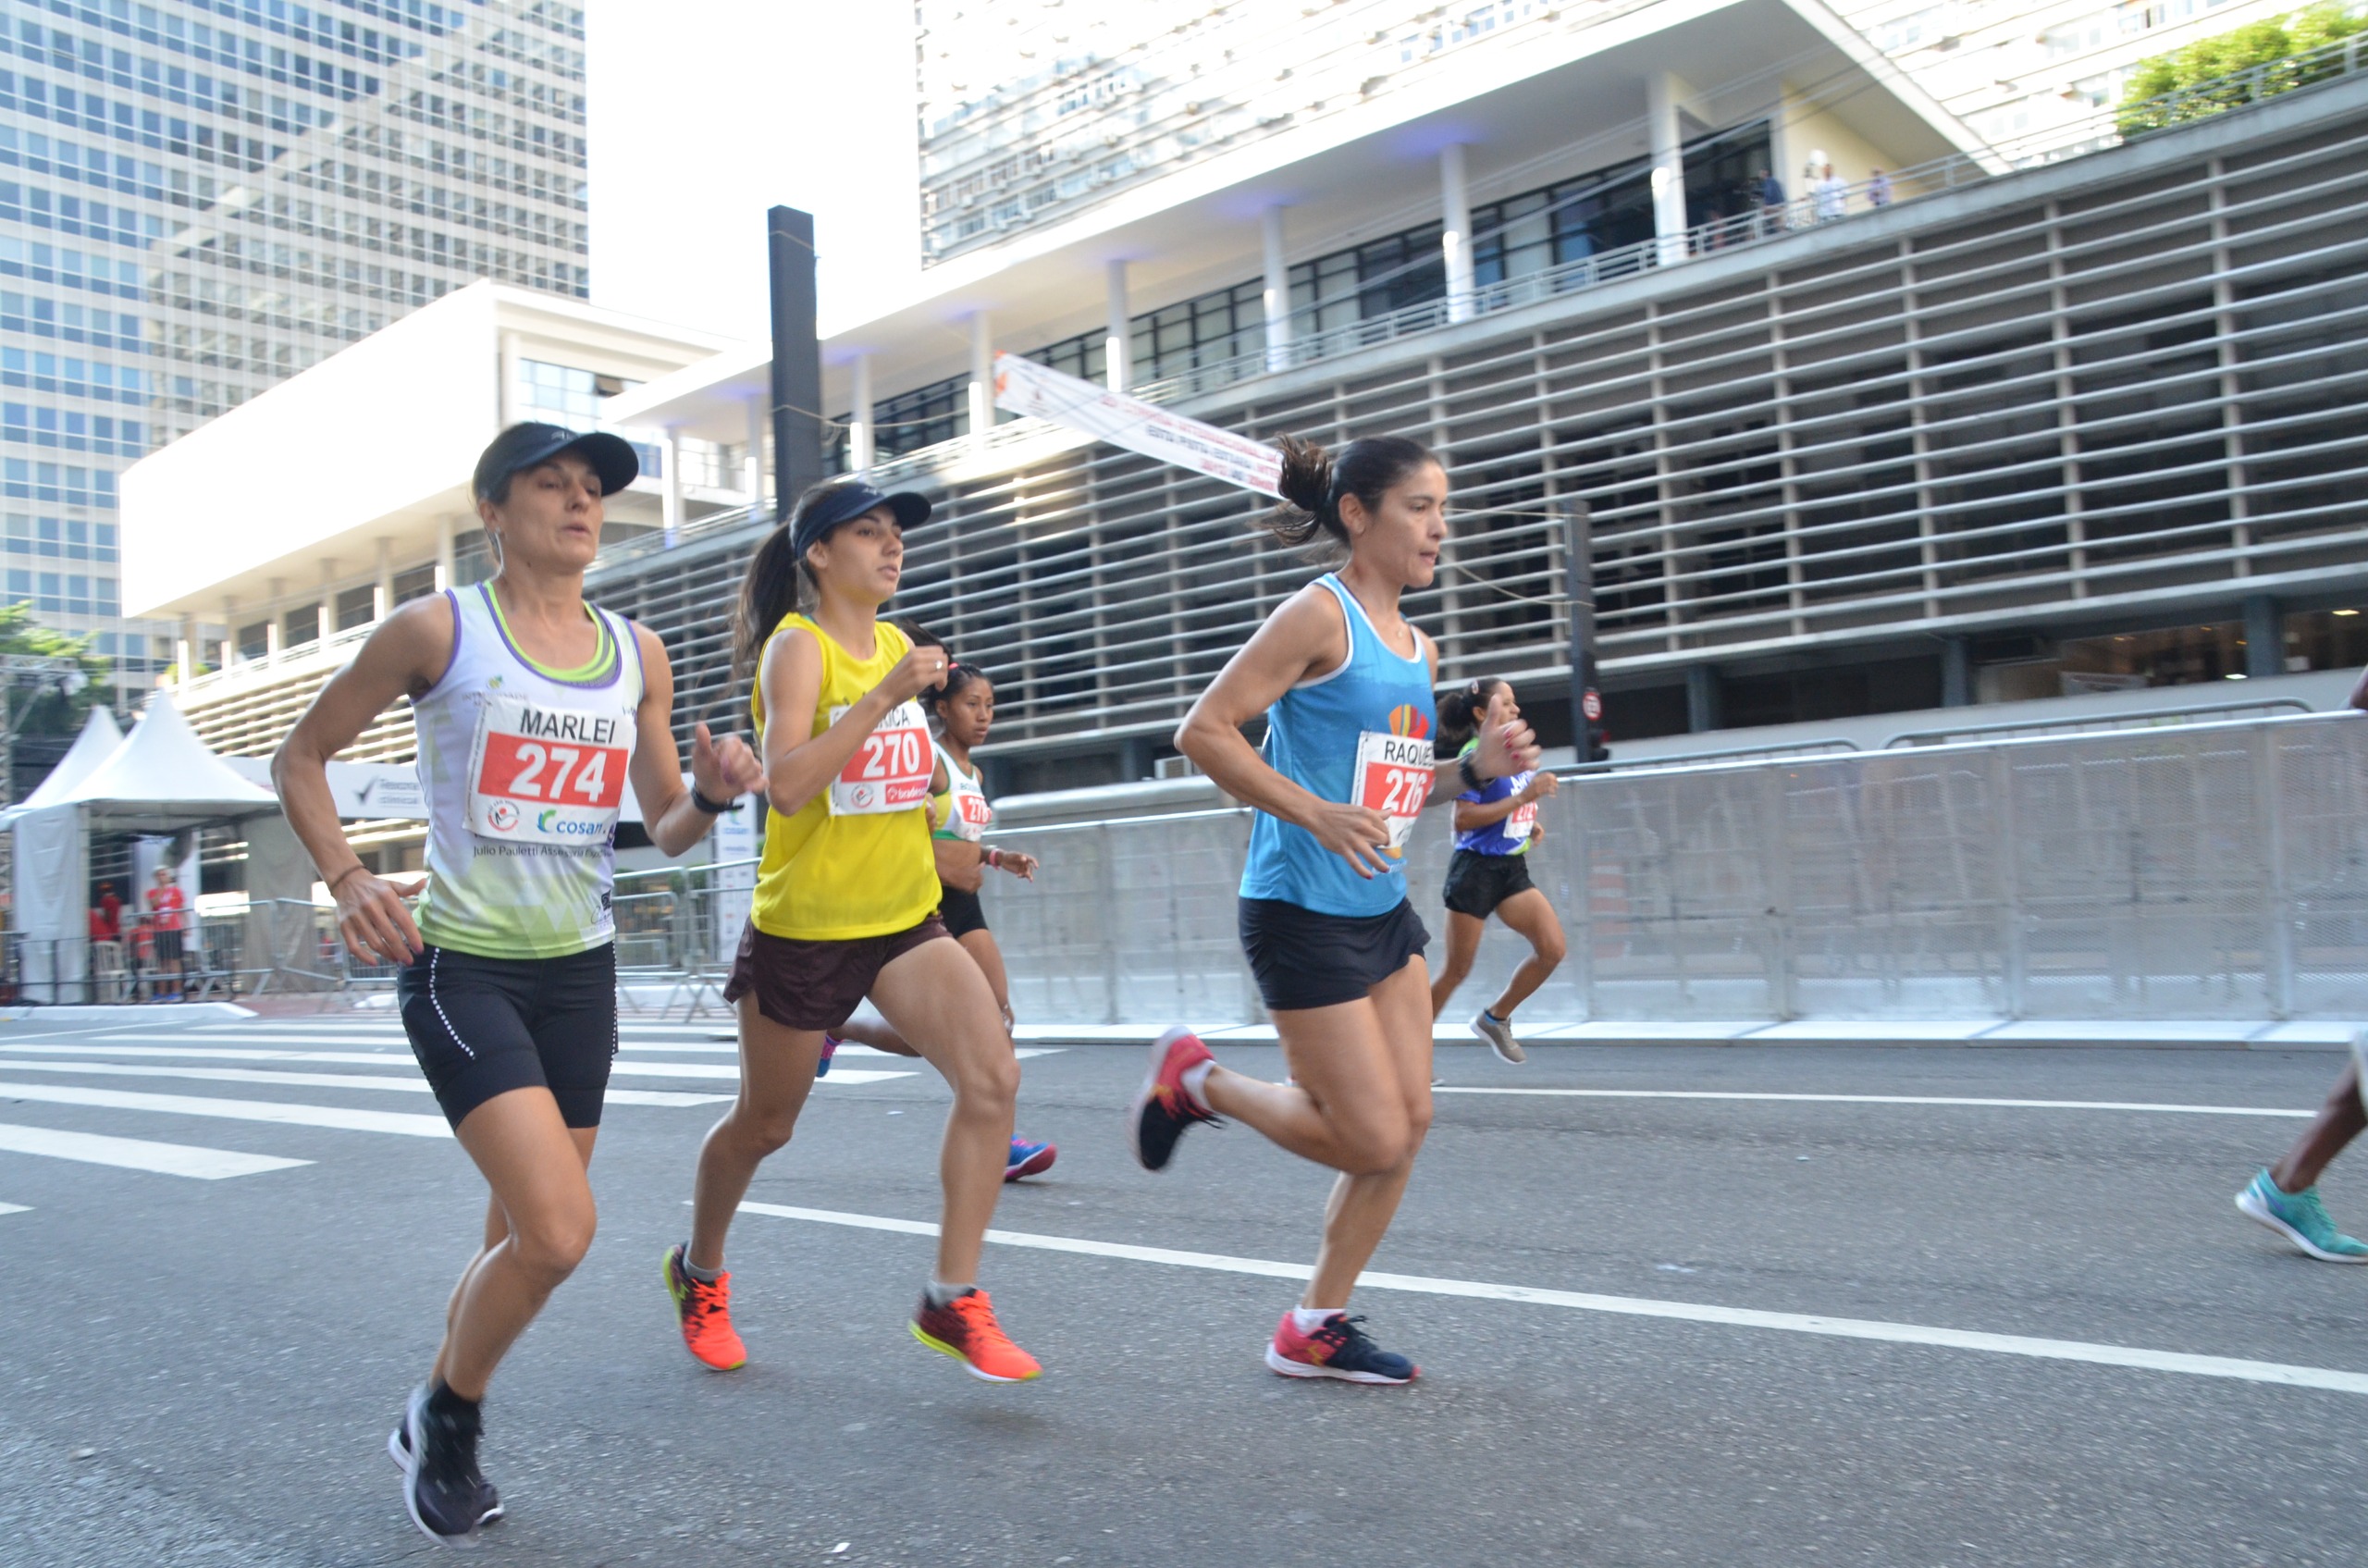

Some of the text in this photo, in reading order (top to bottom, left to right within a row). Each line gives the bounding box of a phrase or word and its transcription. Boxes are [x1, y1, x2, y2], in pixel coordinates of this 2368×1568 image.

[520, 708, 616, 745] MARLEI
[508, 743, 607, 803] 274
[862, 731, 920, 779] 270
[1382, 769, 1427, 814] 276
[474, 846, 496, 857] Julio
[499, 846, 538, 857] Pauletti
